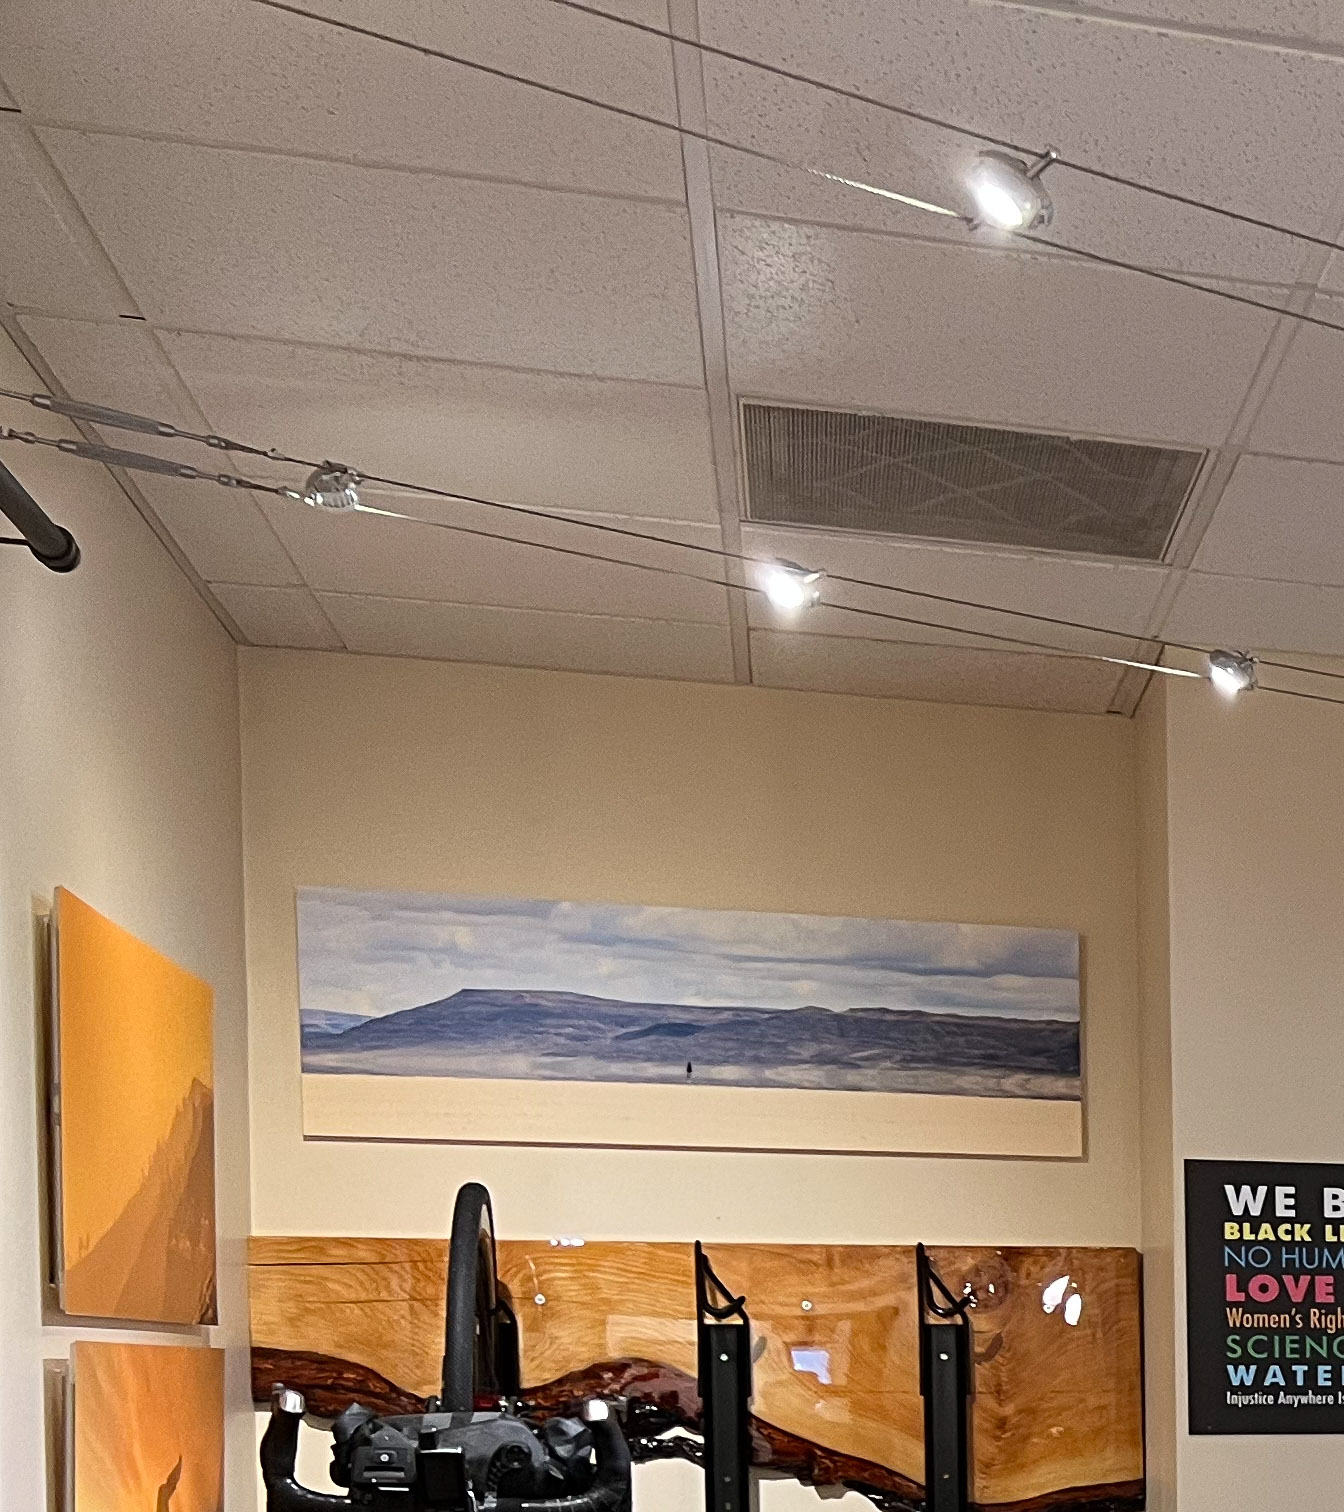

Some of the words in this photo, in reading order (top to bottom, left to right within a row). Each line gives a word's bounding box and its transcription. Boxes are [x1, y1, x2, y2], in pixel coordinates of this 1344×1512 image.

[1224, 1184, 1296, 1218] WE
[1224, 1222, 1312, 1242] BLACK
[1224, 1245, 1271, 1268] NO
[1225, 1274, 1335, 1303] LOVE
[1226, 1308, 1303, 1329] Women's
[1226, 1391, 1274, 1408] Injustice
[1278, 1391, 1334, 1408] Anywhere
